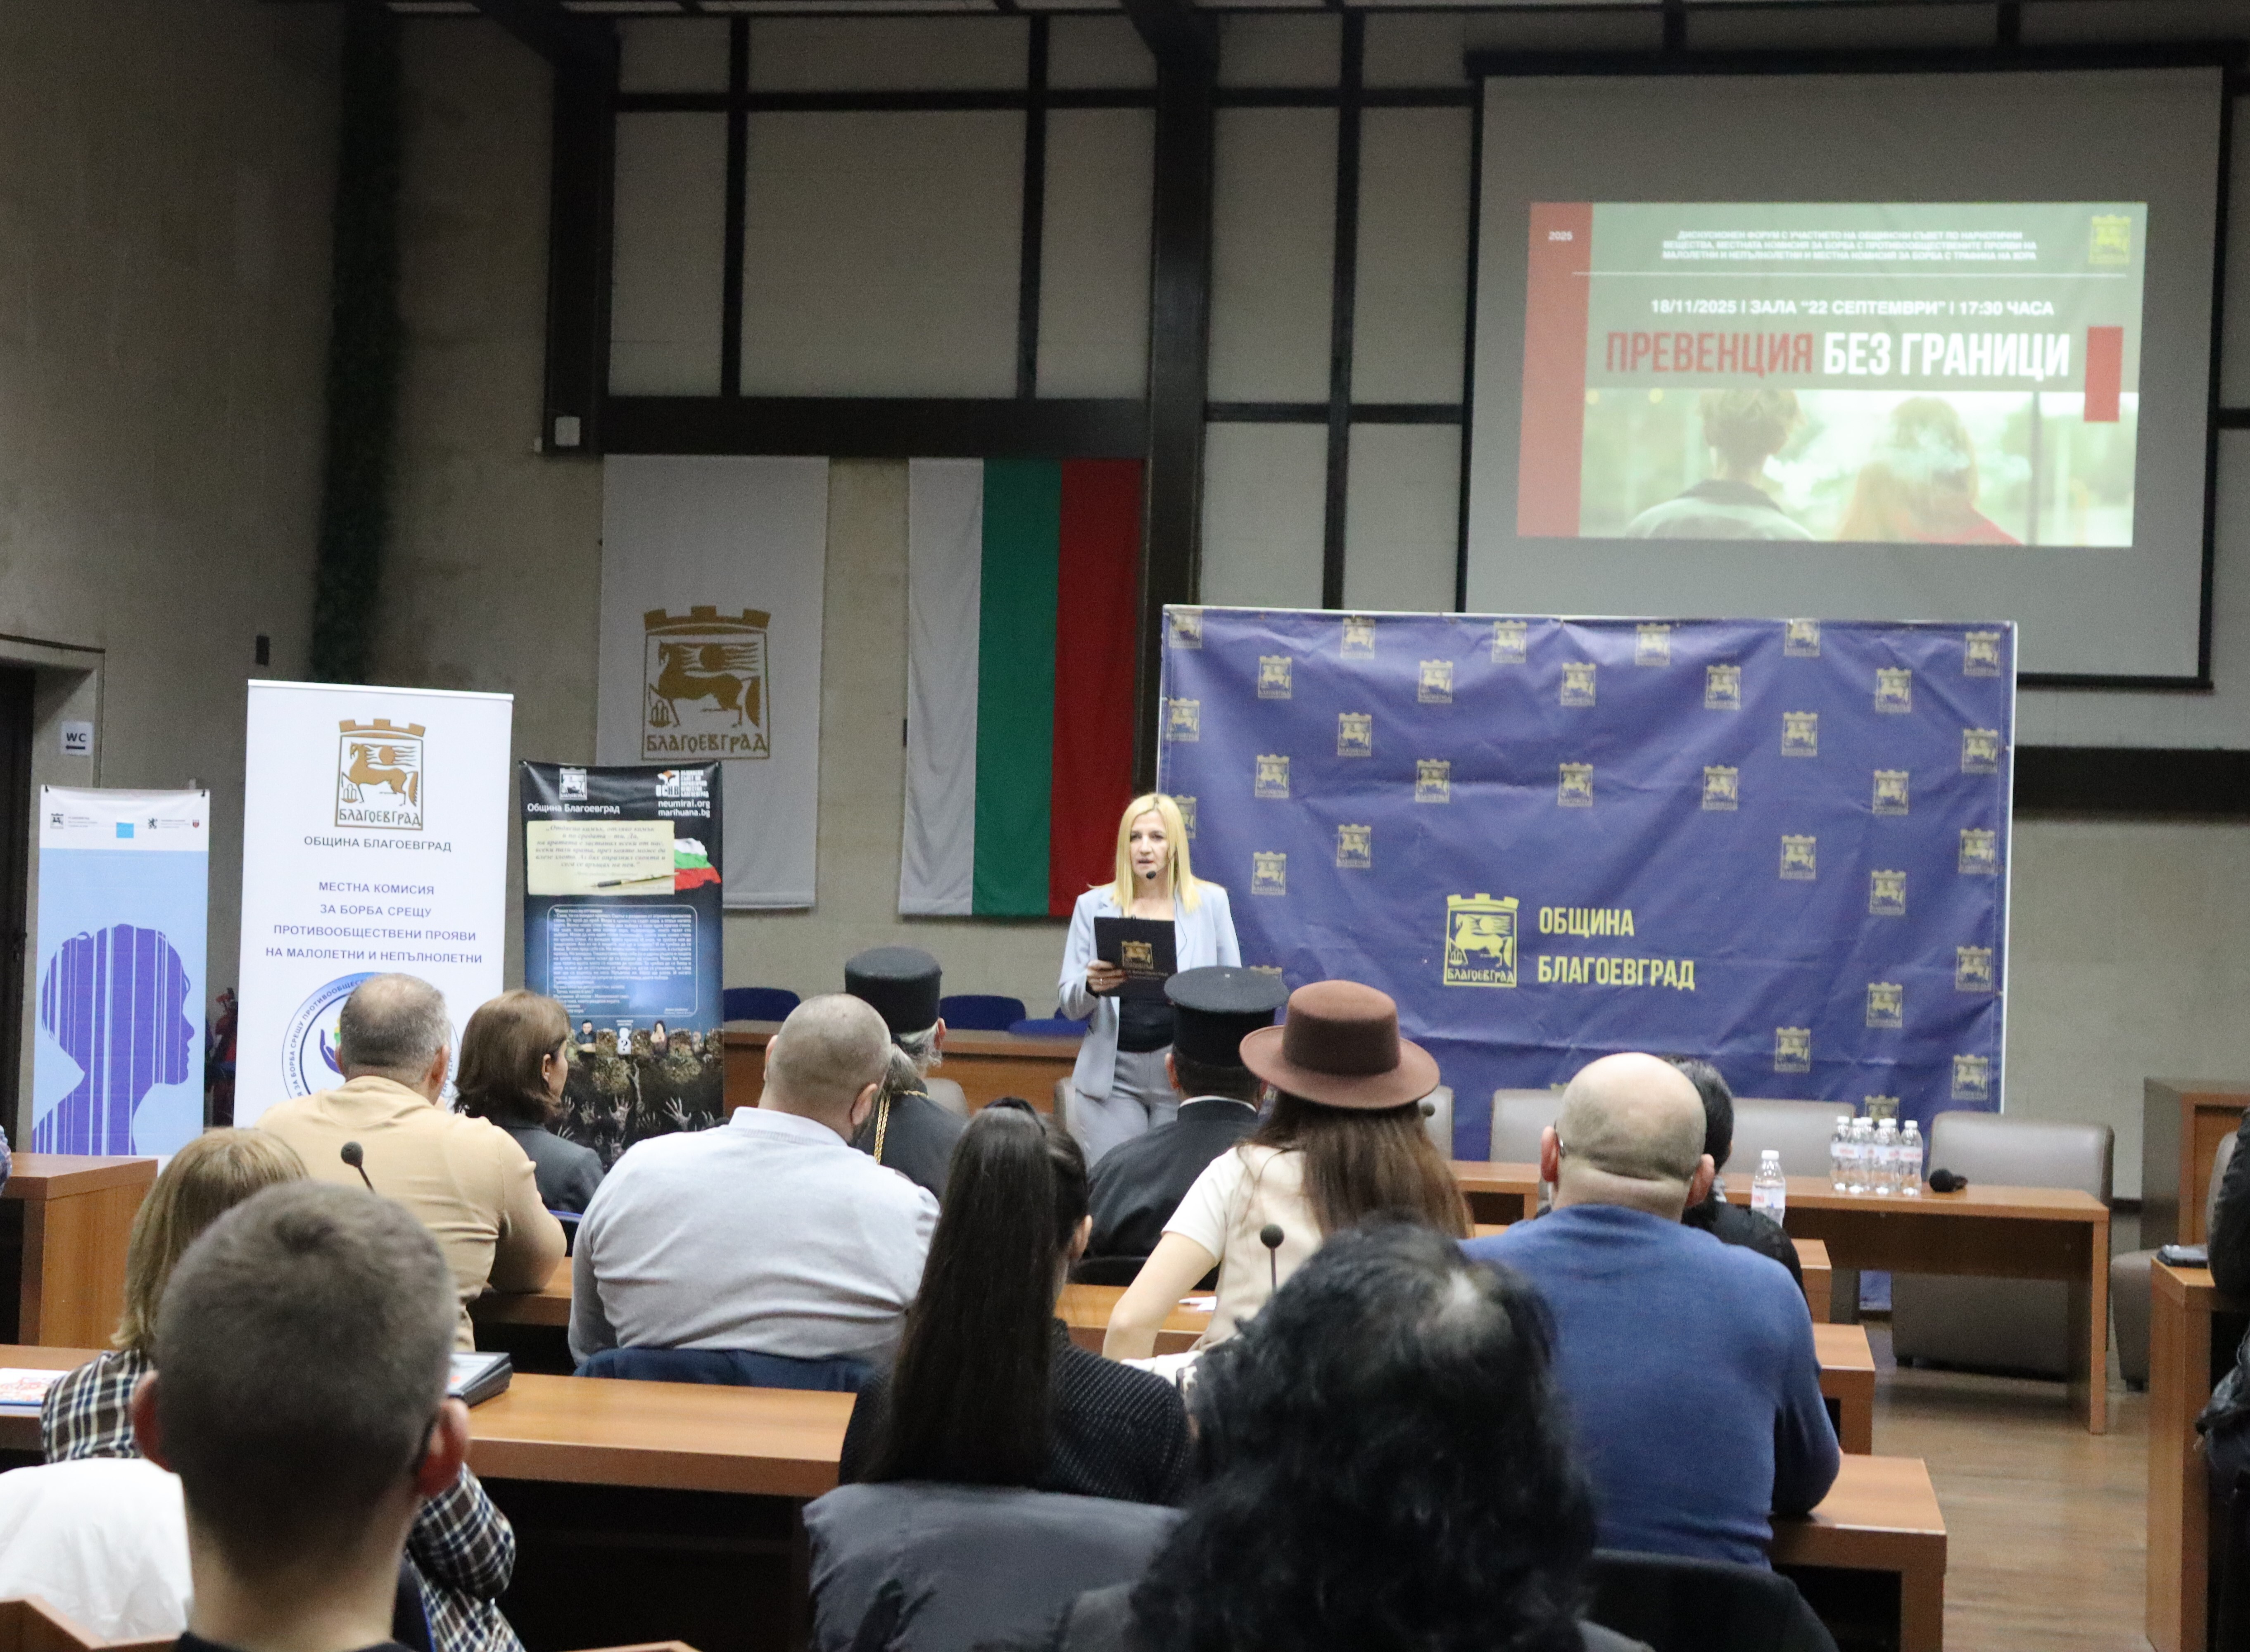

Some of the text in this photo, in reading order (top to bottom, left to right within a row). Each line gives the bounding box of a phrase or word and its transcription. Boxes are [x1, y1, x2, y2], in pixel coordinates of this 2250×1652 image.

[1548, 231, 1573, 240] 2025
[1652, 299, 1737, 314] 18/11/2025
[1750, 300, 1797, 314] ЗАЛА
[1960, 301, 2003, 316] 17:30
[2006, 301, 2054, 316] ЧАСА
[1606, 332, 2070, 381] ПРЕВЕНЦИЯ БЕЗ ГРАНИЦИ
[67, 733, 86, 742] WC
[647, 733, 768, 753] БЛАГОЕВГРАД
[527, 803, 620, 814] Община Благоевград
[658, 808, 710, 818] marihuana.bg
[339, 809, 421, 826] БЛАГОЕВГРАД
[304, 835, 451, 852] ОБЩИНА БЛАГОЕВГРАД
[319, 881, 434, 895] МЕСТНА КОМИСИЯ
[320, 904, 431, 918] ЗА БОРБА СРЕЩУ
[1539, 907, 1635, 938] ОБЩИНА
[274, 925, 476, 941] ПРОТИВООБЩЕСТВЕНИ ПРОЯВИ
[266, 947, 482, 963] НА МАЛОЛЕТНИ И НЕПЪЛНОЛЕТНИ
[1447, 968, 1515, 983] БЛАГОЕВГРАД
[1538, 955, 1695, 990] БЛАГОЕВГРАД
[291, 1021, 304, 1048] СРЕЩУ
[293, 1080, 300, 1089] ЗА
